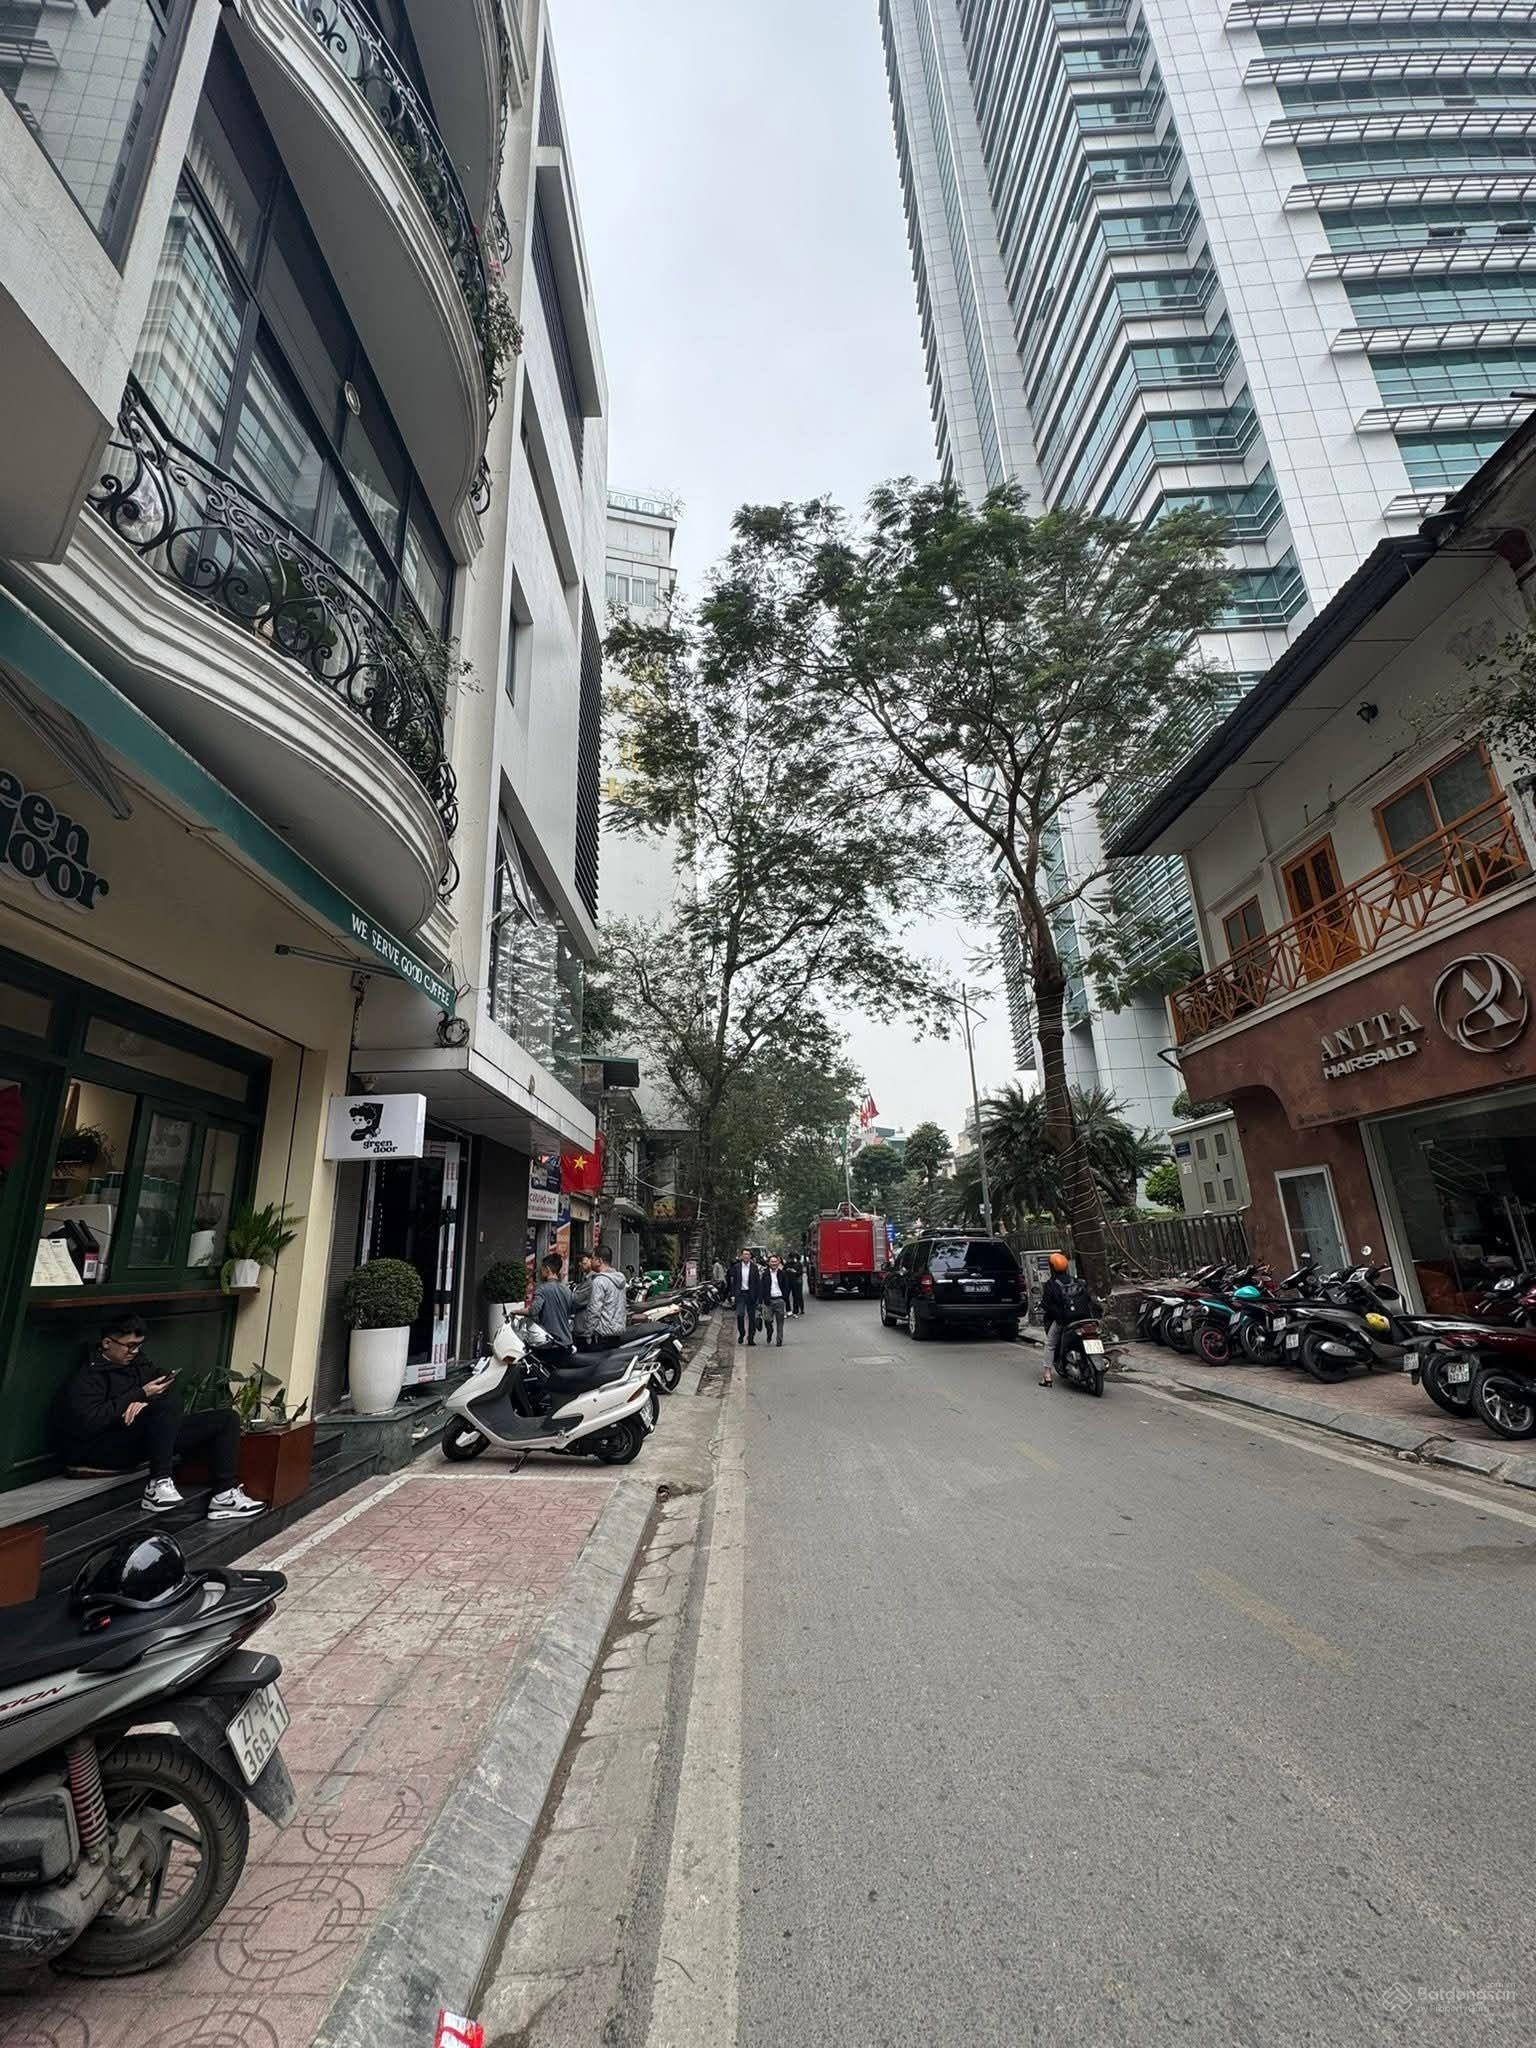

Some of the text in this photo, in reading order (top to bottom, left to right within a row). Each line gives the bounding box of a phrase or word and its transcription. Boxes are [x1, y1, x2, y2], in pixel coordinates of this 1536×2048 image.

[351, 912, 368, 940] WE
[371, 929, 400, 966] SERVE
[401, 956, 423, 984] GOOD
[1321, 1003, 1424, 1061] ANITA
[363, 1139, 393, 1150] green
[373, 1144, 398, 1154] door
[244, 1703, 286, 1775] 369.11
